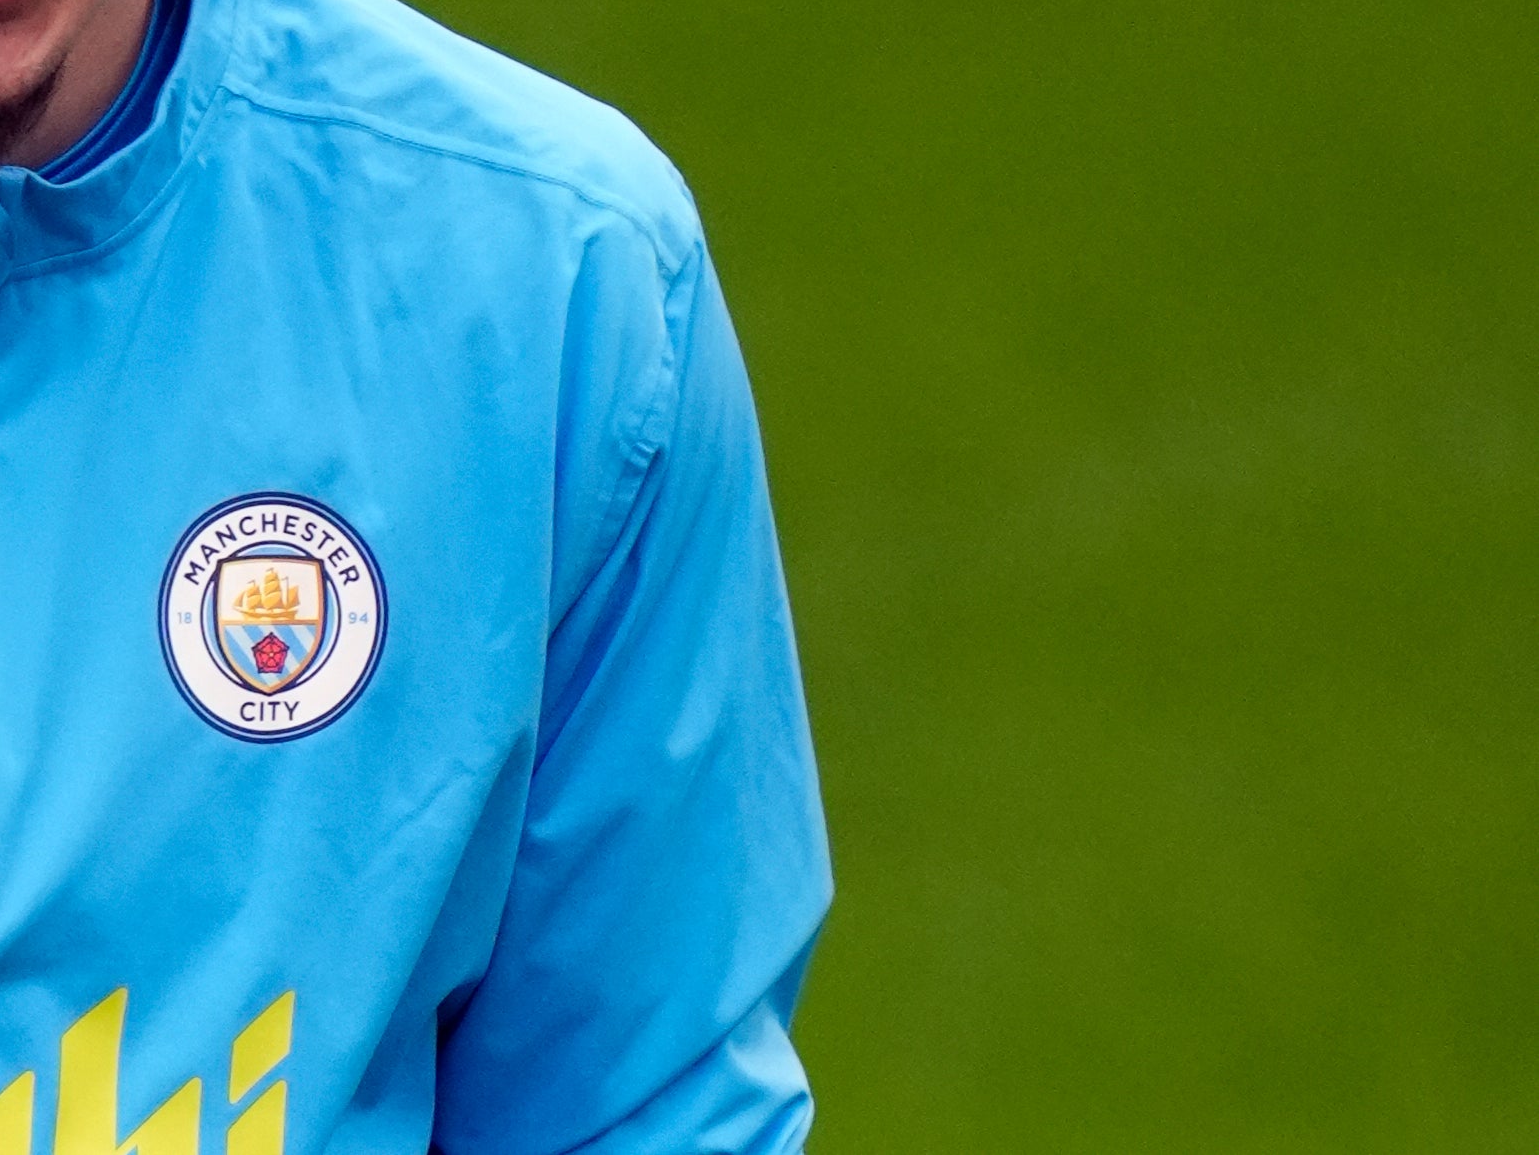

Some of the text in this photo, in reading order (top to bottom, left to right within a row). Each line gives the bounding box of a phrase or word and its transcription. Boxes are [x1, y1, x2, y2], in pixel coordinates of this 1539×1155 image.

[184, 514, 360, 586] MANCHESTER
[177, 612, 369, 624] 18 94
[239, 701, 301, 722] CITY
